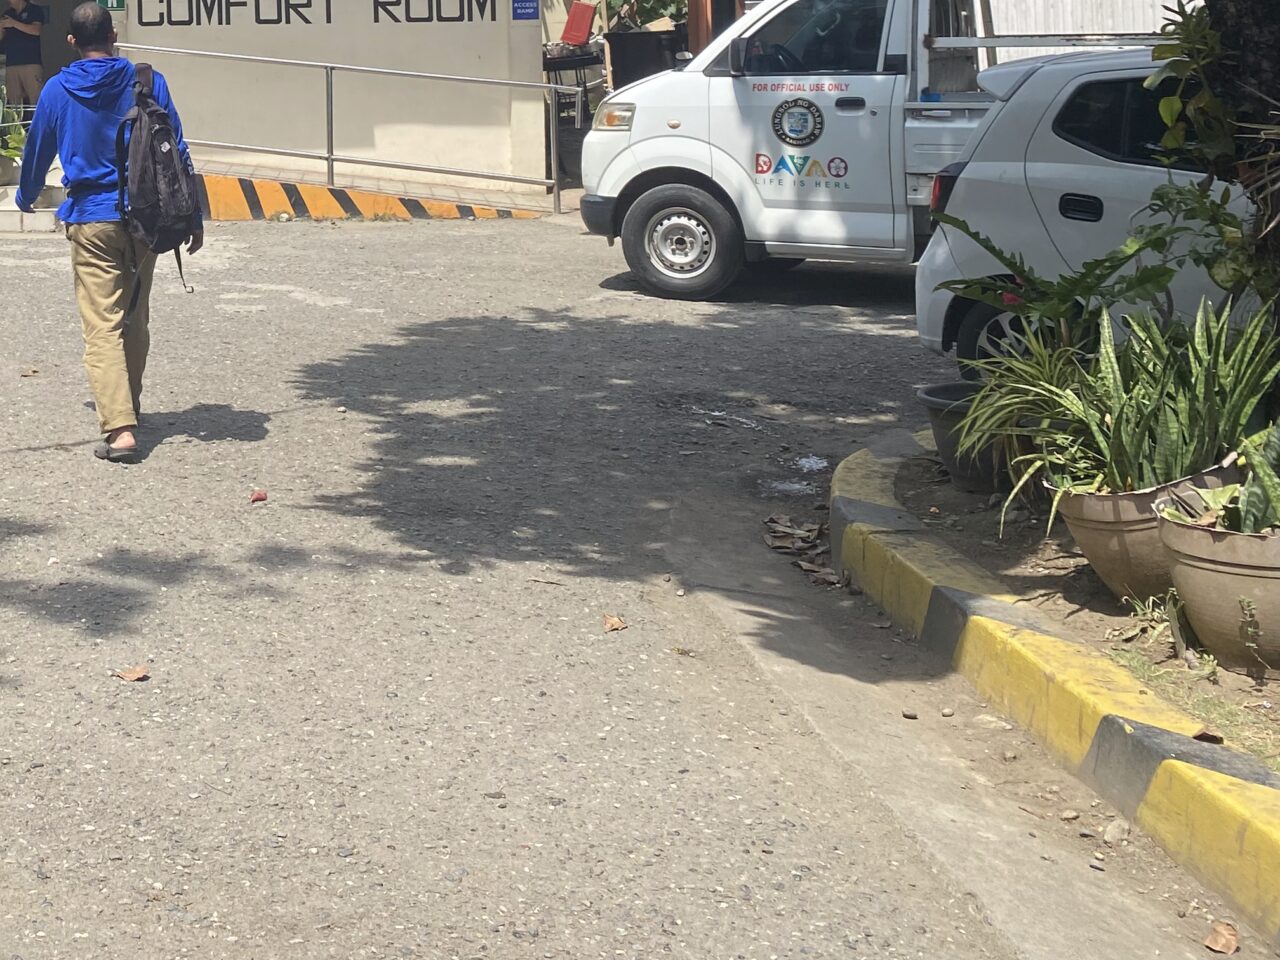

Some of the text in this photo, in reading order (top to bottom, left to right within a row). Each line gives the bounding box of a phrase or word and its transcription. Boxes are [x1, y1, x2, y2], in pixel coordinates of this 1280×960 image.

[752, 83, 850, 92] FOR OFFICIAL USE ONLY
[755, 153, 848, 178] DAVAO
[755, 178, 783, 186] LIFE
[793, 179, 805, 187] IS
